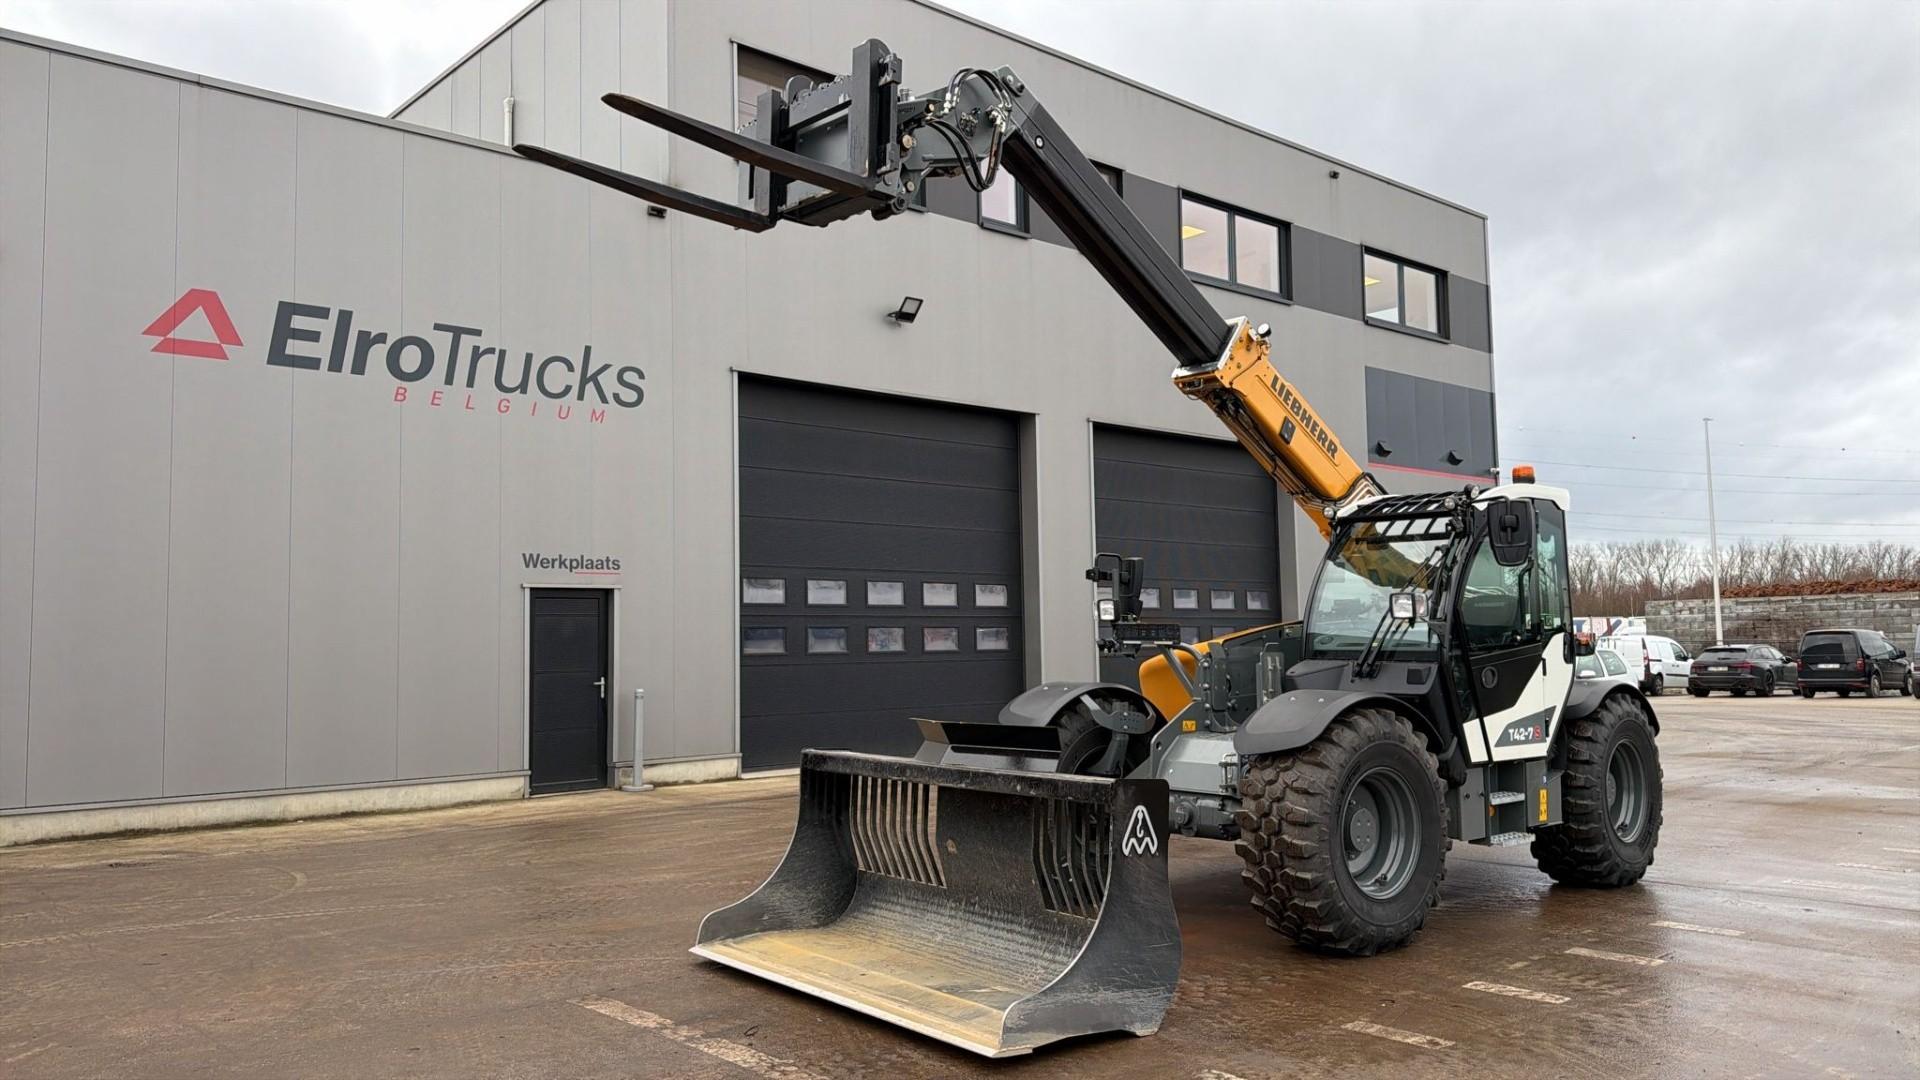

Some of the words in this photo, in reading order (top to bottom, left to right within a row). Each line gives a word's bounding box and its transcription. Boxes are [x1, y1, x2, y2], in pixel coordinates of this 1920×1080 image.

[266, 300, 646, 408] ElroTrucks
[394, 386, 606, 424] BELGIUM
[1270, 374, 1338, 460] LIEBHERR
[522, 552, 621, 573] Werkplaats
